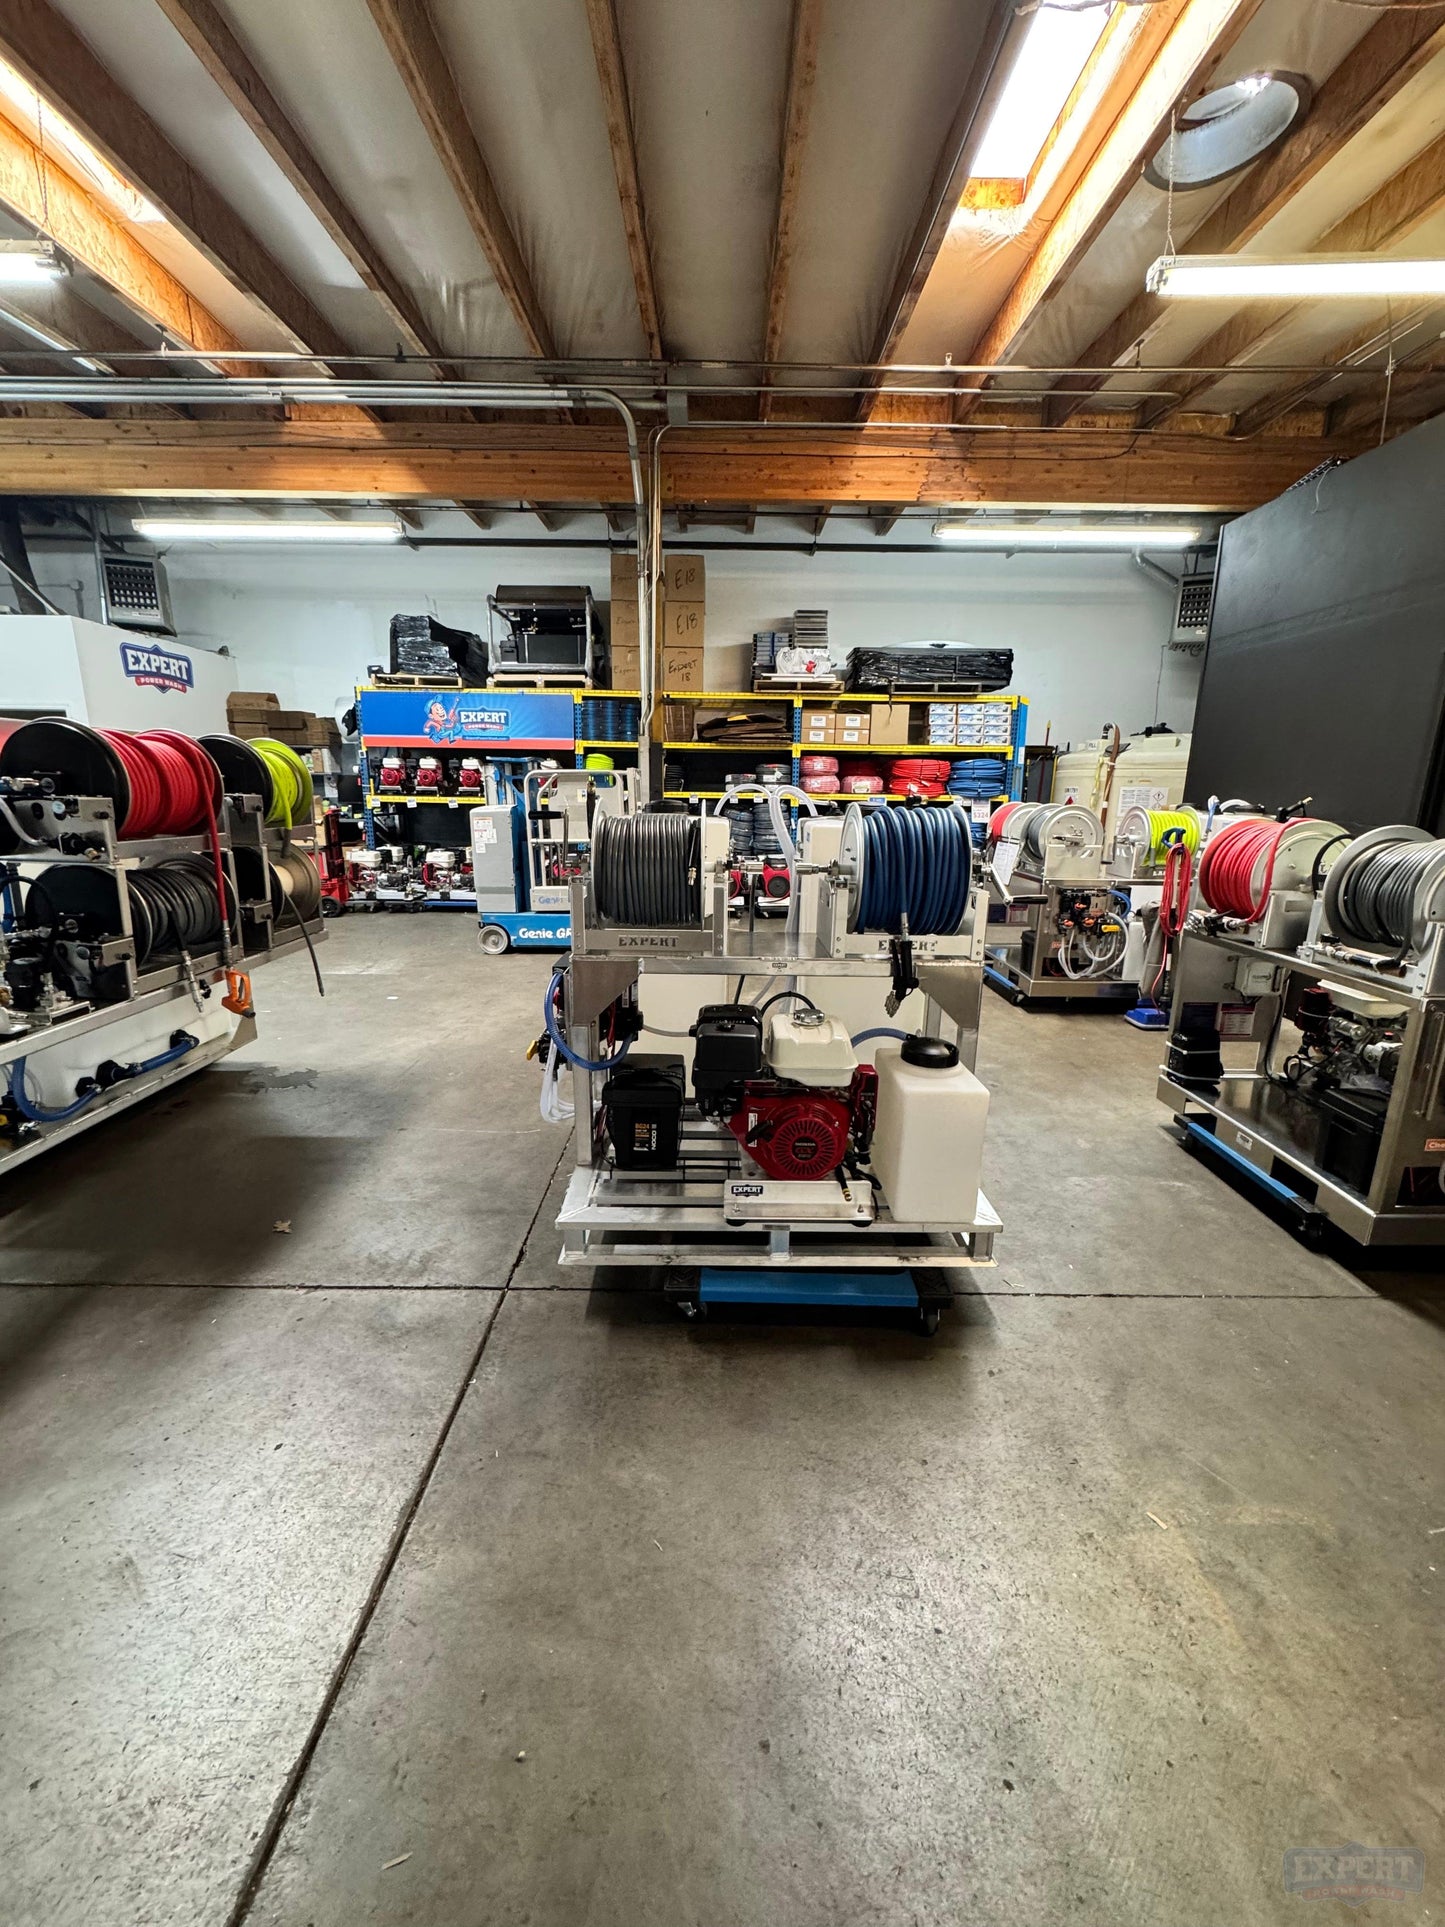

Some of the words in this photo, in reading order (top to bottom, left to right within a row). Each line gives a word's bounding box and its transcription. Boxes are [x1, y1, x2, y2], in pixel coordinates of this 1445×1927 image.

[125, 648, 189, 681] EXPERT
[681, 671, 691, 682] 18
[140, 677, 164, 685] POWER
[165, 679, 183, 690] WASH
[460, 711, 507, 724] EXPERT
[518, 928, 554, 939] Genie
[618, 934, 679, 947] EXPERT
[878, 939, 938, 952] EERT
